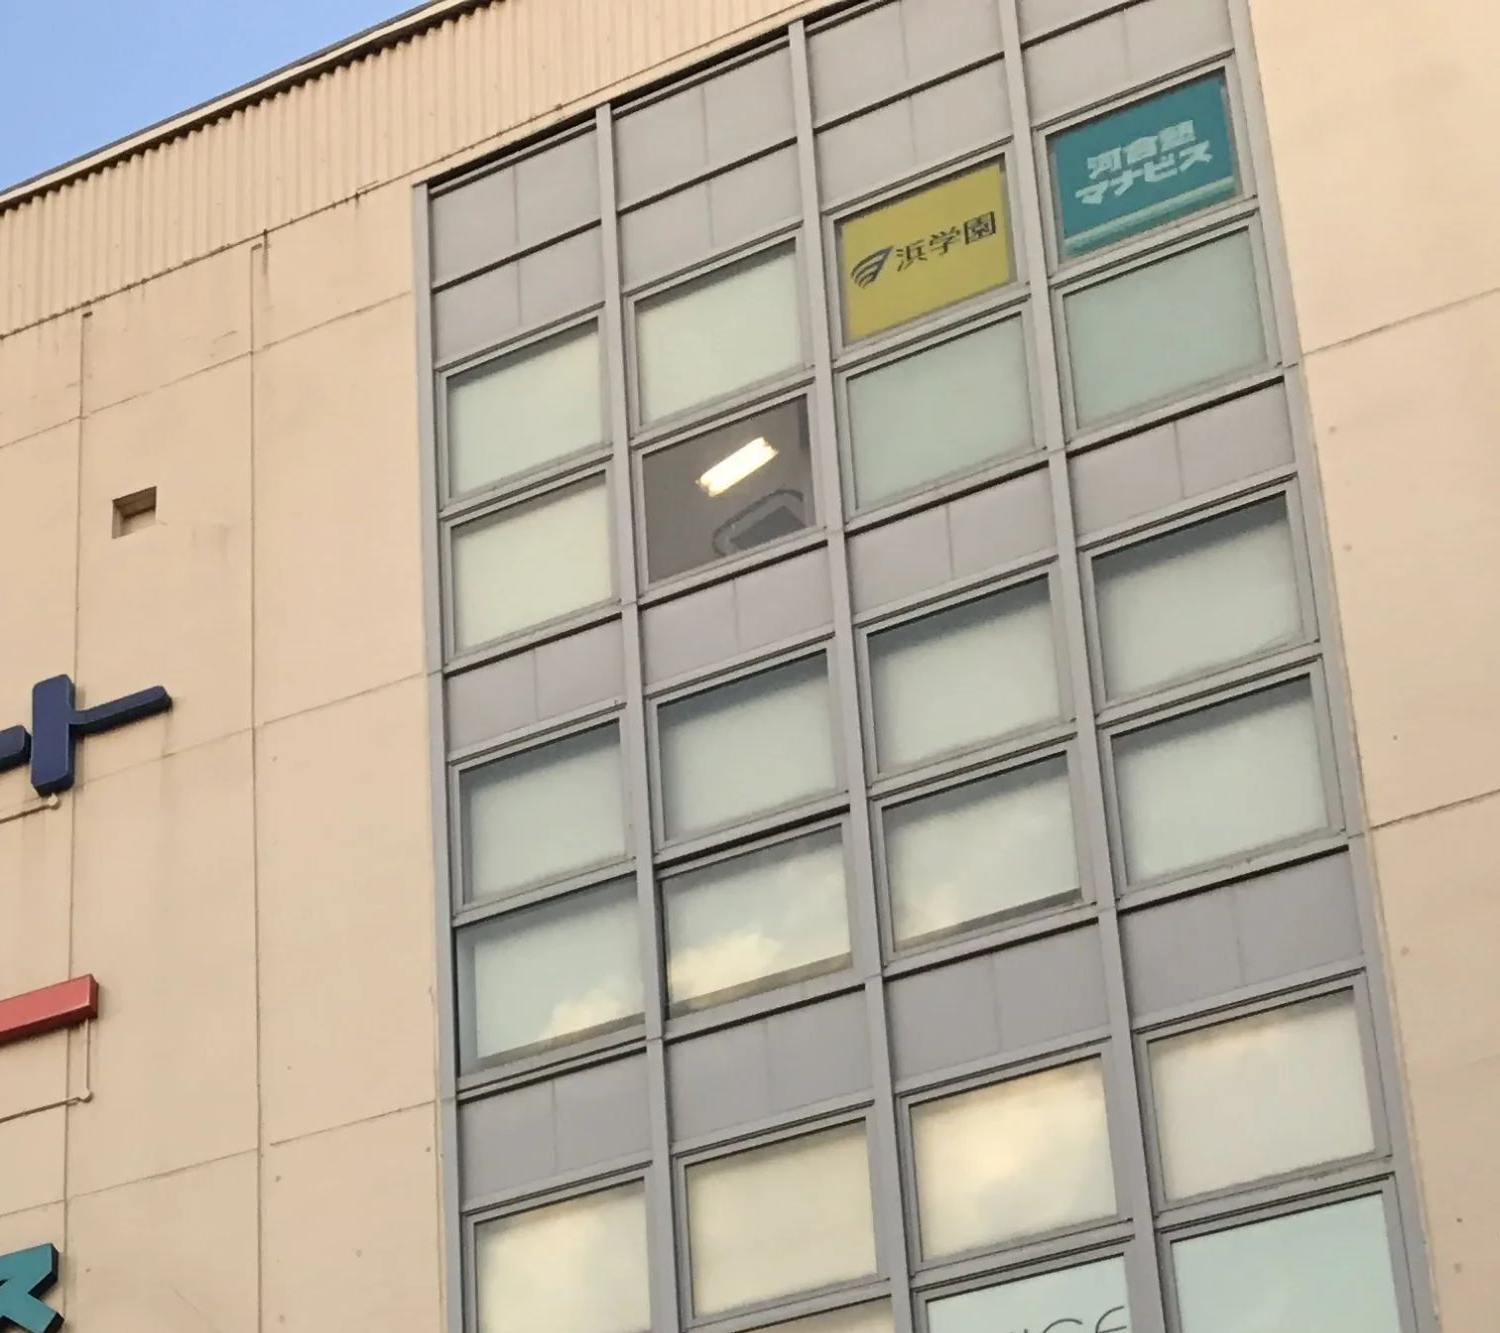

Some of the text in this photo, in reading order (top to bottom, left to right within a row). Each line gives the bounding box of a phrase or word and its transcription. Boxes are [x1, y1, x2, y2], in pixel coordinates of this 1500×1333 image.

[1075, 140, 1213, 204] マナビス
[895, 210, 997, 272] 浜学園
